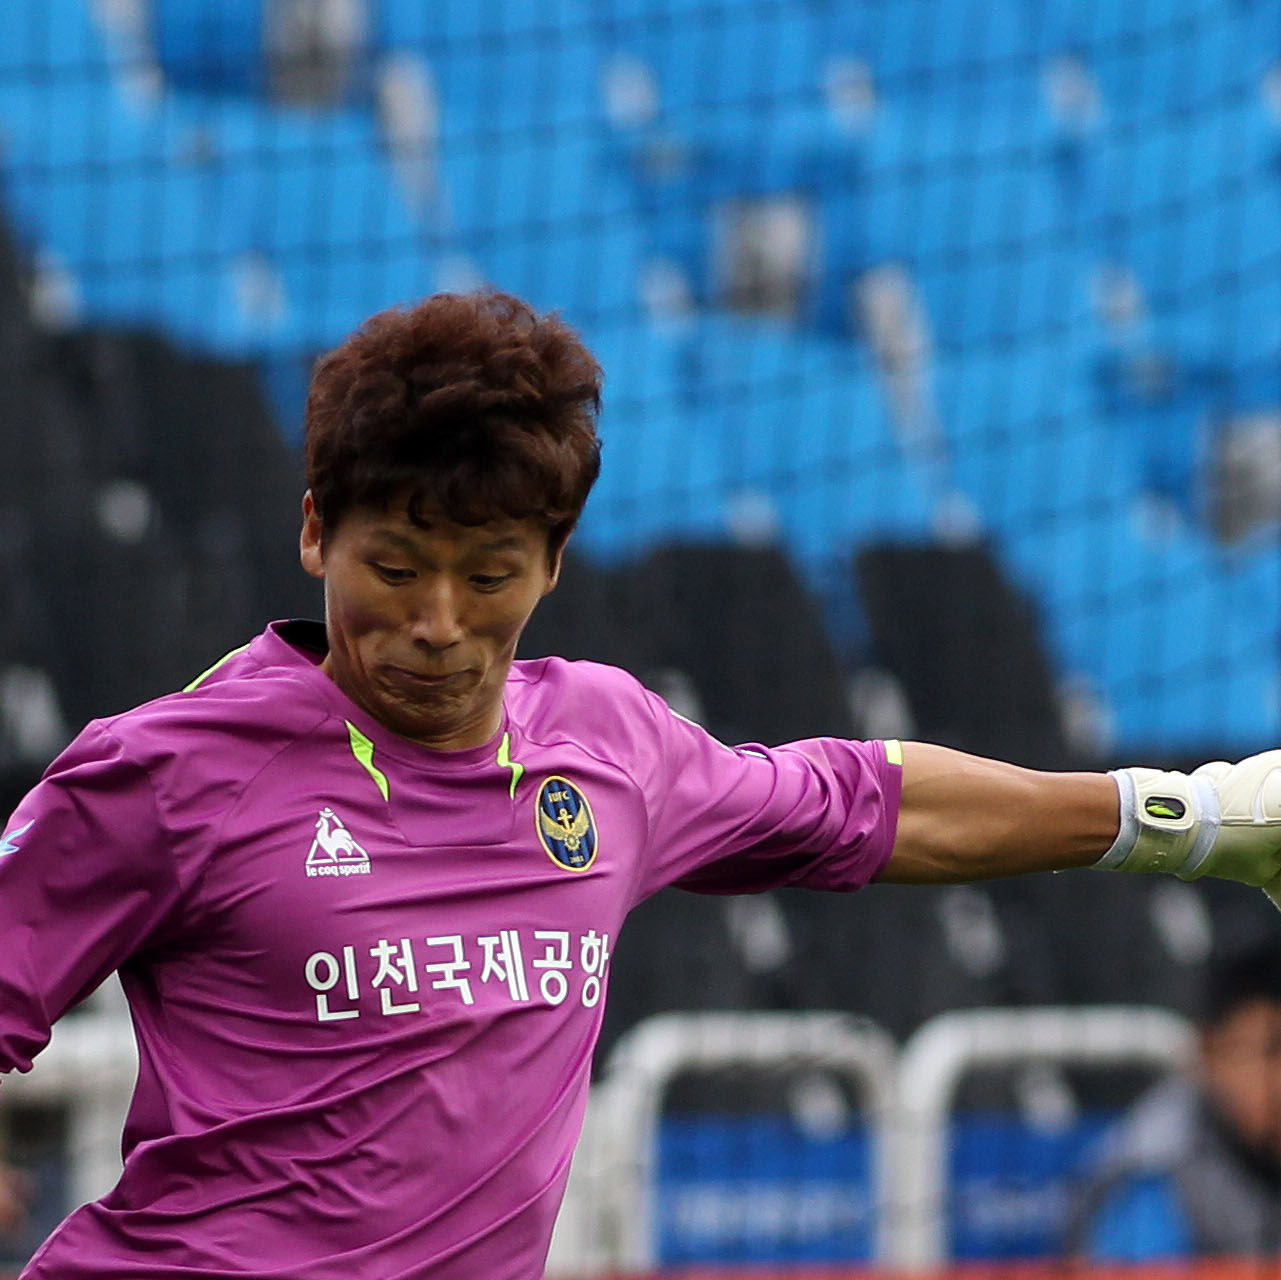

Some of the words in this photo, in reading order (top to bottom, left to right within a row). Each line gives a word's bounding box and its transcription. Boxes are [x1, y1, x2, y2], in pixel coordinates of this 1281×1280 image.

[305, 864, 317, 878] le
[317, 865, 340, 877] coq
[339, 861, 372, 877] sportif
[305, 929, 610, 1022] 인천국제공항
